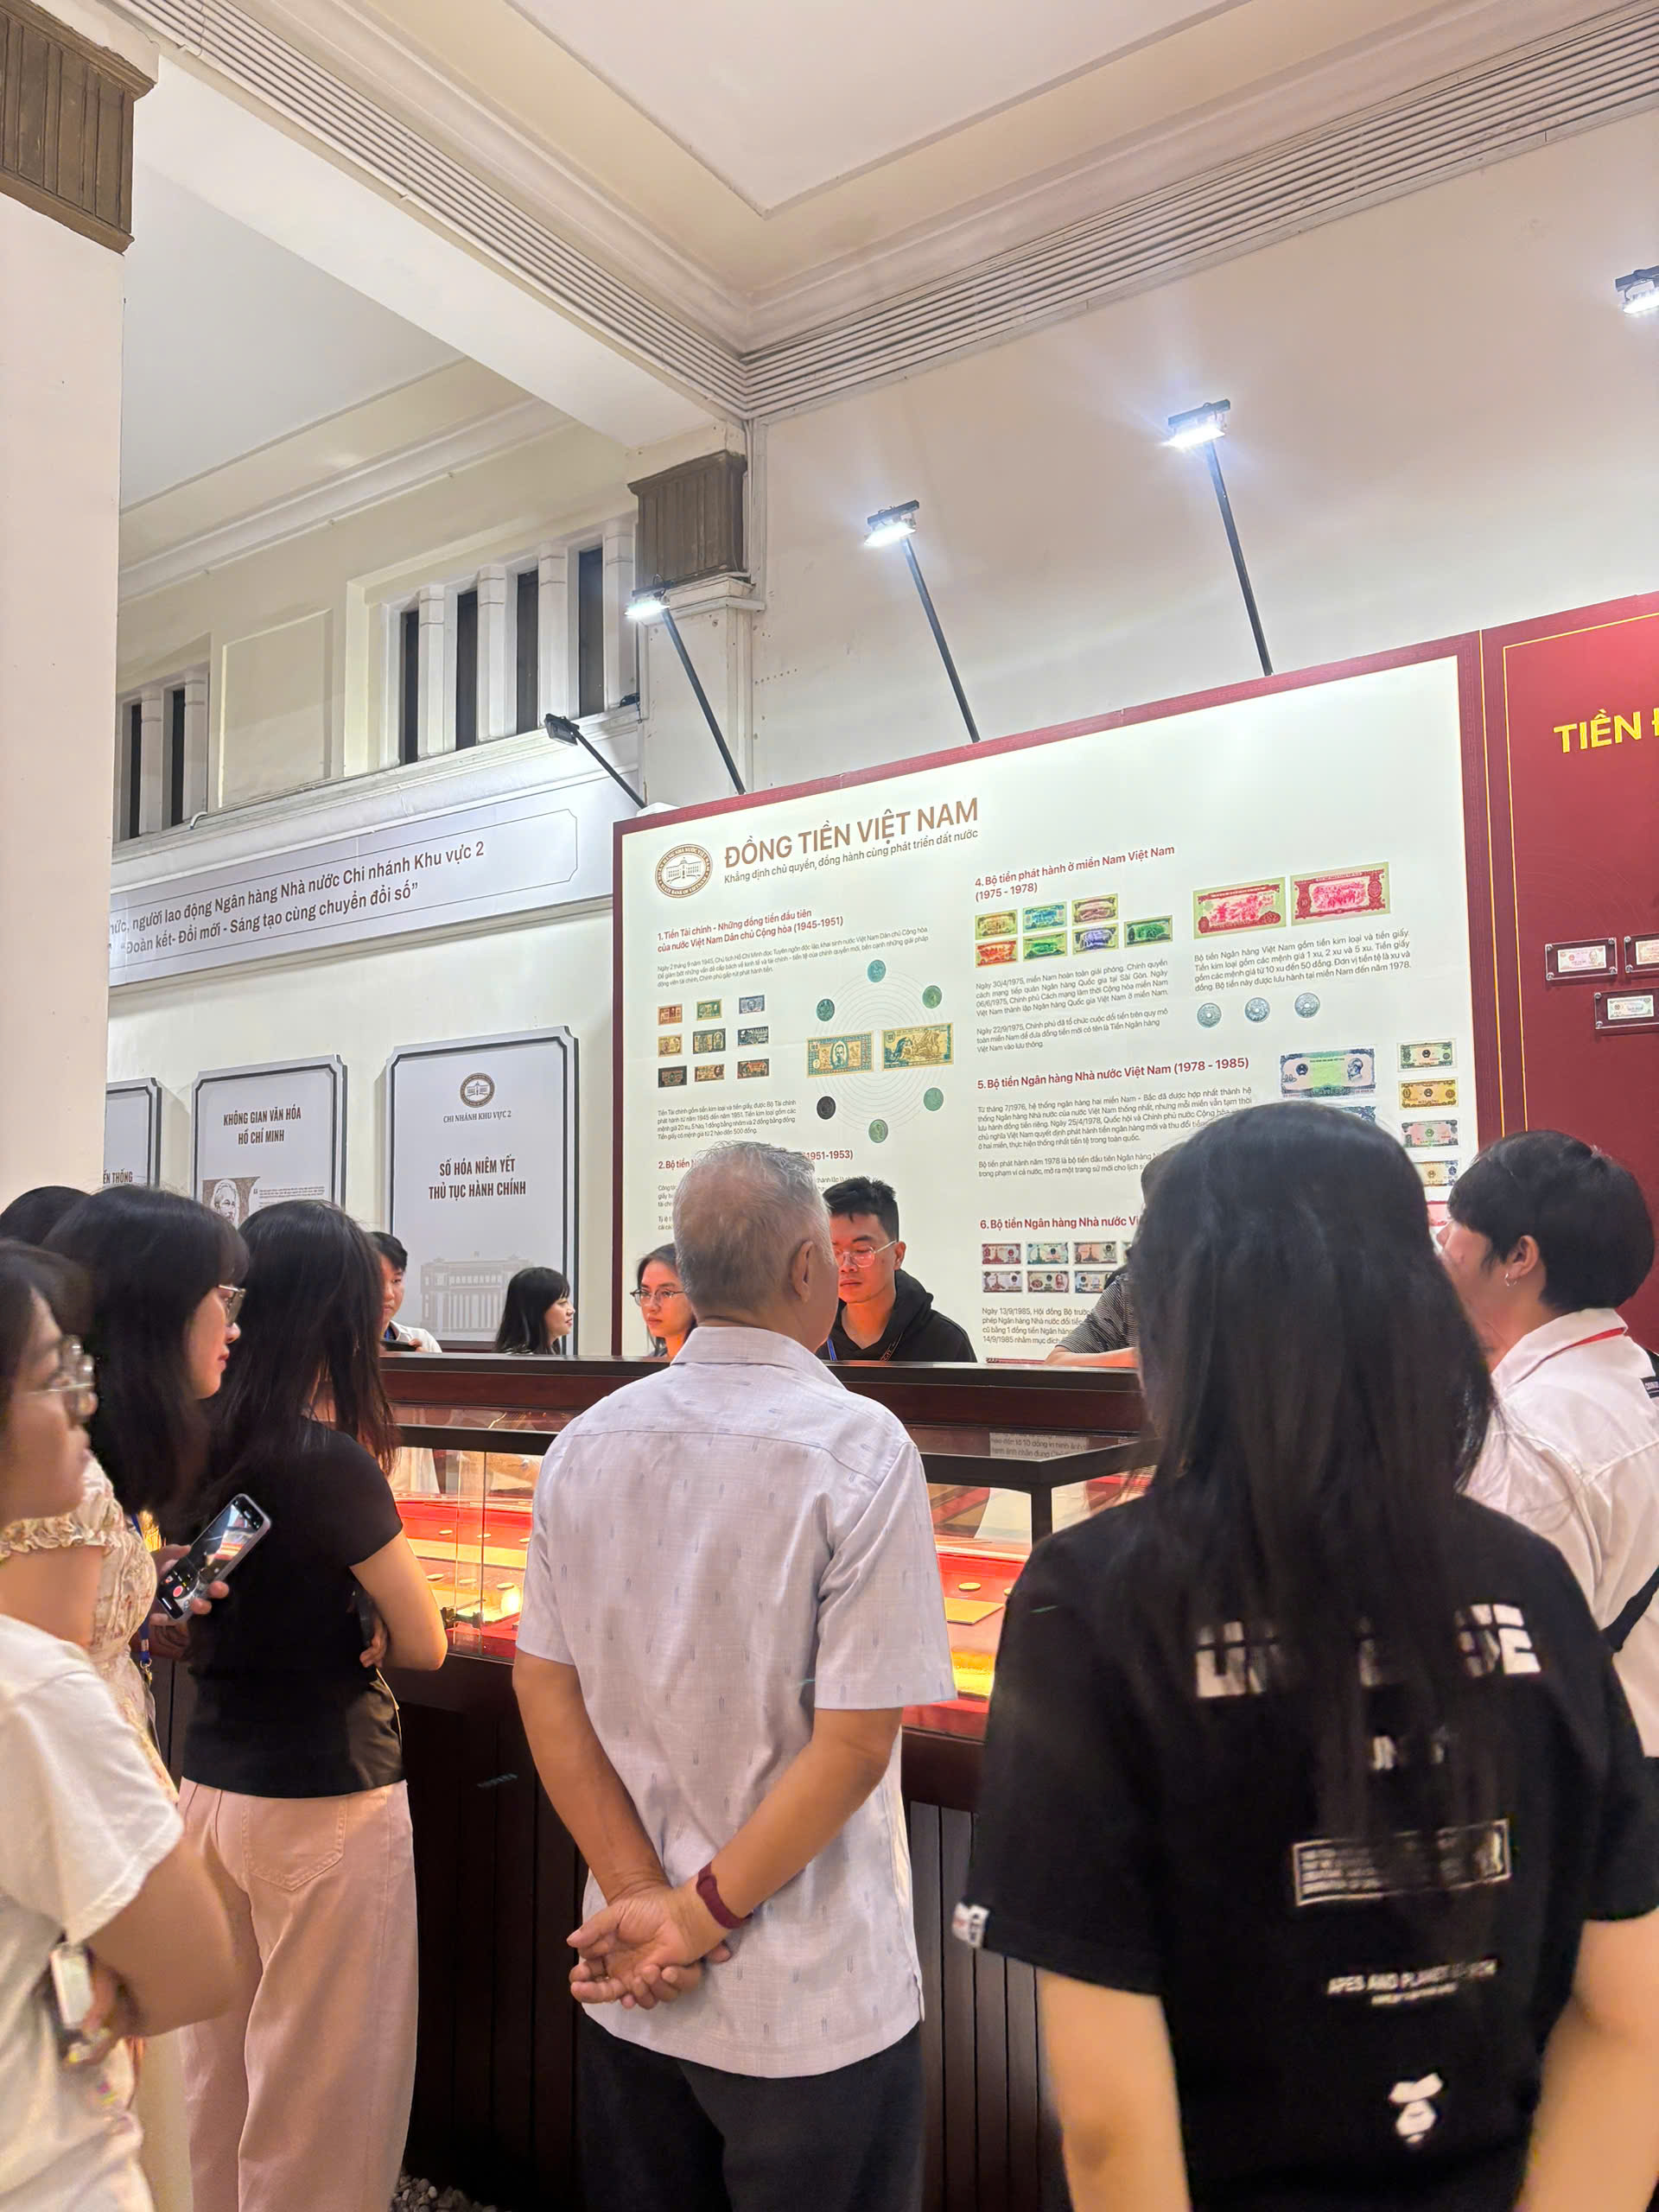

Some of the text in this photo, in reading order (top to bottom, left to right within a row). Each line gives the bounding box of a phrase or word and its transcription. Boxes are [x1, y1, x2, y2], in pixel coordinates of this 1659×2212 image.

[1554, 709, 1642, 753] TIỀN
[725, 798, 978, 868] ĐỒNG TIỀN VIỆT NAM
[724, 829, 978, 884] Khẳng định chủ quyền, đồng hành cùng phát triển đất nước
[975, 846, 1175, 887] 4. Bộ tiền phát hành ở miền Nam Việt Nam
[132, 910, 162, 931] người
[164, 909, 181, 924] lao
[183, 900, 213, 920] động
[214, 893, 245, 913] Ngân
[248, 887, 278, 906] hàng
[281, 879, 306, 899] Nhà
[308, 873, 340, 893] nước
[343, 866, 365, 885] Chi
[368, 856, 410, 880] nhánh
[414, 851, 442, 870] Khu
[445, 843, 472, 865] vực
[475, 841, 484, 857] 2
[975, 887, 1002, 903] (1975
[1009, 881, 1038, 895] 1978)
[156, 929, 176, 949] kết-
[178, 924, 197, 944] Đổi
[200, 921, 221, 940] mới
[230, 915, 260, 933] Sáng
[263, 912, 283, 930] tạo
[285, 904, 316, 923] cùng
[319, 890, 367, 916] chuyển
[370, 884, 391, 906] đổi
[394, 879, 418, 901] số”
[657, 916, 844, 953] của nước Việt Nam Dân chủ Cộng hòa (1945-1951)
[977, 1079, 987, 1090] 5.
[987, 1077, 1000, 1090] Bộ
[1001, 1075, 1020, 1088] tiền
[1020, 1074, 1047, 1087] Ngân
[1048, 1072, 1073, 1084] hàng
[1075, 1070, 1096, 1082] Nhà
[1096, 1068, 1122, 1080] nước
[1123, 1065, 1145, 1079] Việt
[1147, 1065, 1172, 1076] Nam
[1173, 1060, 1206, 1075] (1978
[1215, 1057, 1249, 1070] 1985)
[223, 1103, 302, 1127] KHÔNG GIAN VĂN HÓA
[442, 1109, 512, 1123] CHI NHÁNH KHU VỰC 2
[238, 1127, 285, 1145] HỒ CHÍ MINH
[439, 1154, 516, 1177] SỐ HÓA NIÊM YẾT
[658, 1160, 666, 1170] 2.
[665, 1160, 676, 1171] Bộ
[676, 1157, 690, 1168] tiền
[429, 1177, 526, 1202] THỦ TỤC HÀNH CHÍNH
[980, 1219, 989, 1230] 6.
[990, 1218, 1003, 1231] Bộ
[1004, 1217, 1023, 1229] tiền
[1024, 1217, 1051, 1230] Ngân
[1052, 1217, 1077, 1230] hàng
[1078, 1216, 1100, 1227] Nhà
[1101, 1216, 1127, 1227] nước
